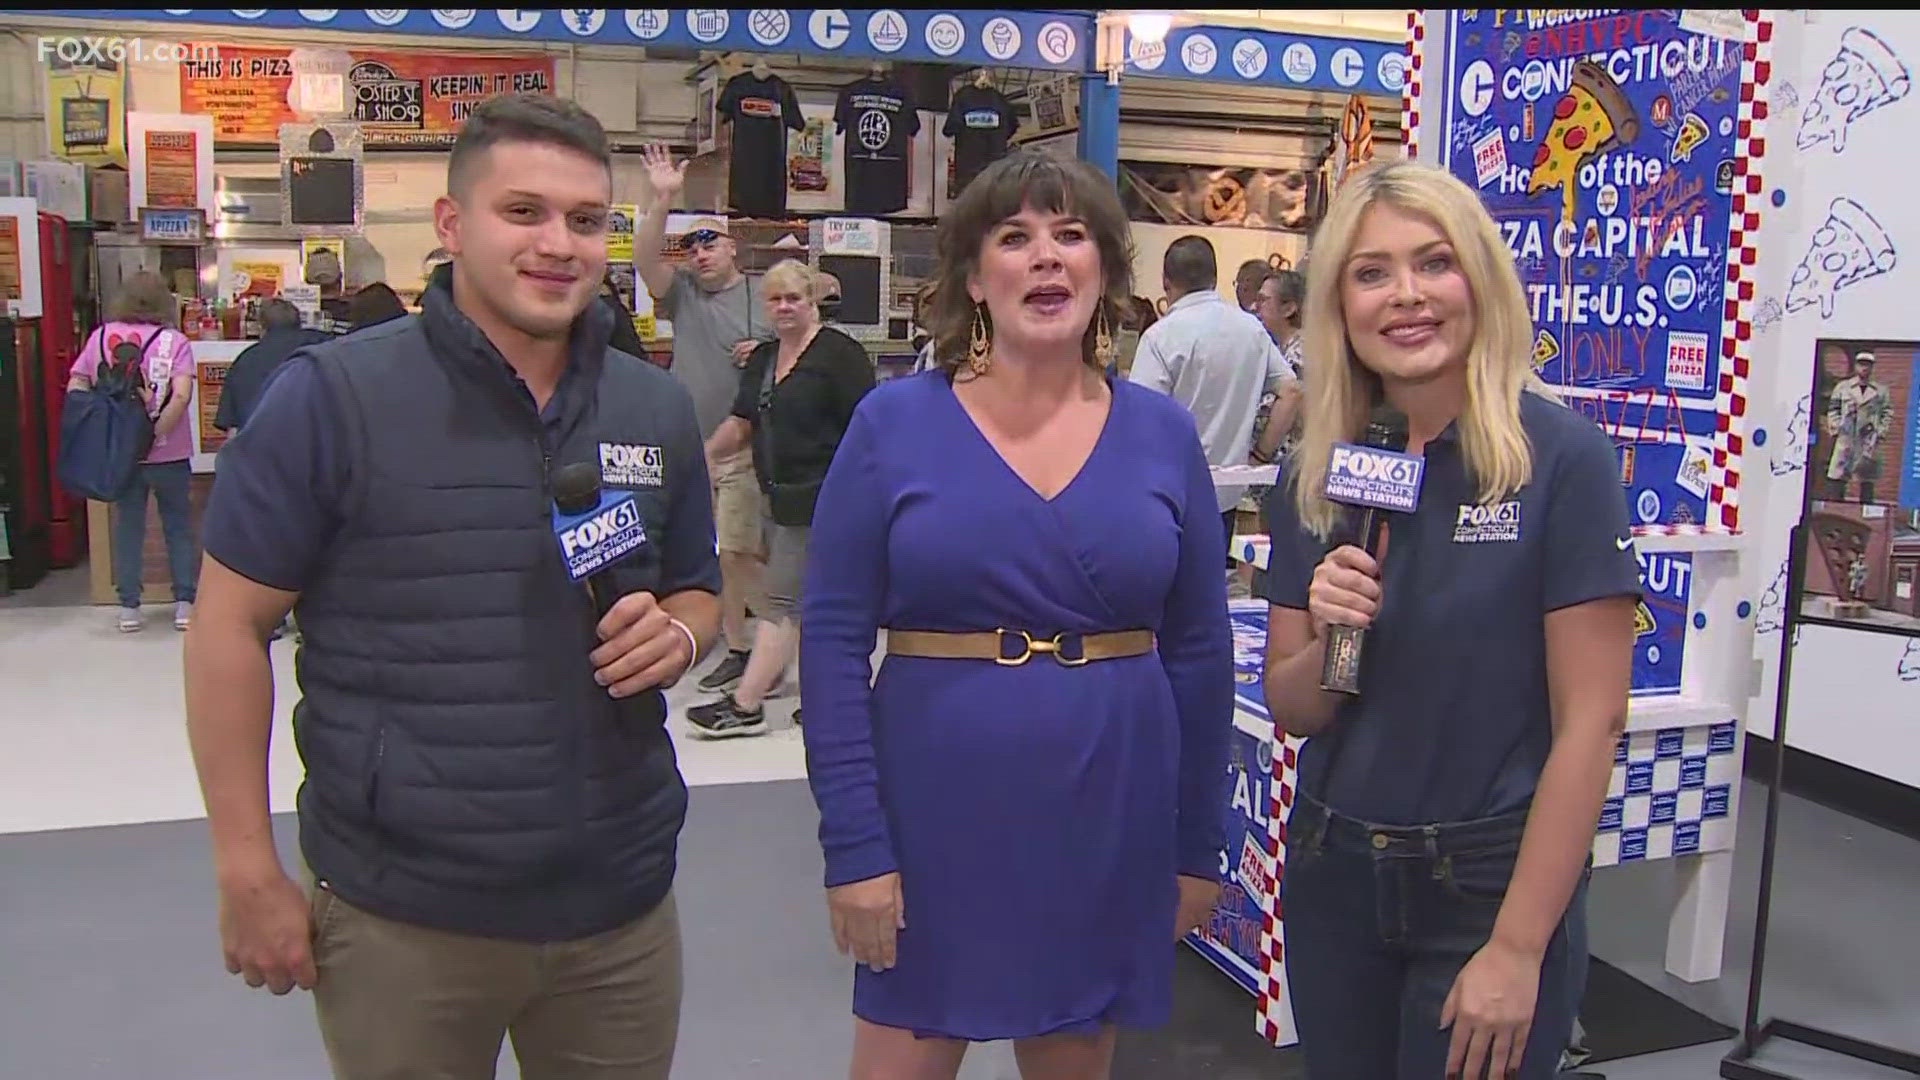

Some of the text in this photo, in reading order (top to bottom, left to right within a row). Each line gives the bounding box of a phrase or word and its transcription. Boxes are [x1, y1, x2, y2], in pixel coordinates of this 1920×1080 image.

[186, 61, 222, 78] THIS
[230, 60, 243, 78] IS
[251, 59, 292, 77] PIZZ
[493, 75, 506, 93] IT
[513, 72, 548, 93] REAL
[1580, 156, 1607, 189] of
[1613, 152, 1662, 186] the
[1553, 215, 1709, 258] CAPITAL
[1669, 346, 1704, 363] FREE
[1667, 364, 1703, 377] APIZZA
[1326, 484, 1413, 507] NEWS STATION
[1479, 532, 1518, 542] STATION
[604, 534, 646, 562] STATION
